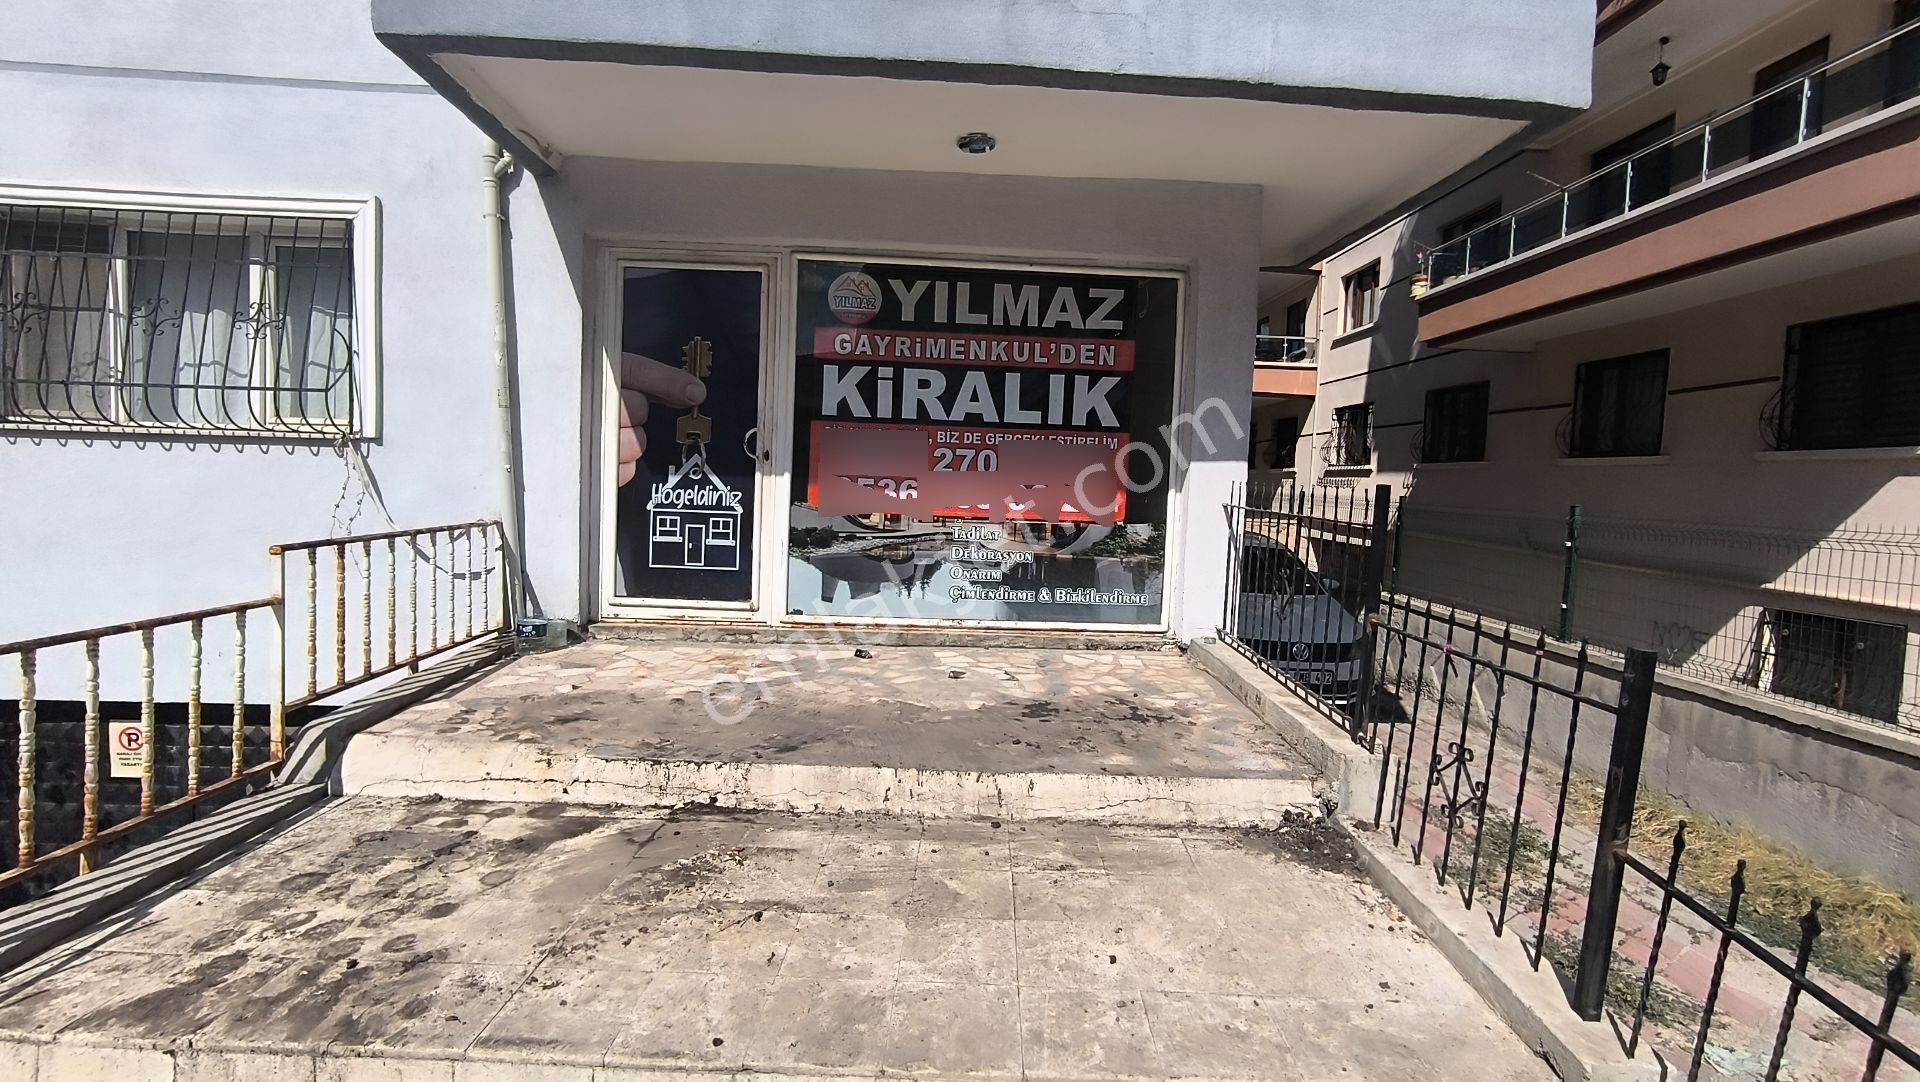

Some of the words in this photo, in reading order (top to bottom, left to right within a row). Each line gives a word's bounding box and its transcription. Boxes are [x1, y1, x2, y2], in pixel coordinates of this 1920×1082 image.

[833, 295, 877, 309] YILMAZ
[888, 278, 1125, 331] YILMAZ
[937, 429, 960, 444] BİZ
[964, 432, 982, 445] DE
[932, 447, 998, 471] 270
[950, 525, 1001, 541] Tadilat
[949, 546, 1034, 565] Dekorasyon
[949, 585, 1036, 604] Çimlendirme
[1038, 587, 1053, 604] &
[1054, 588, 1150, 606] Bitkilendirme
